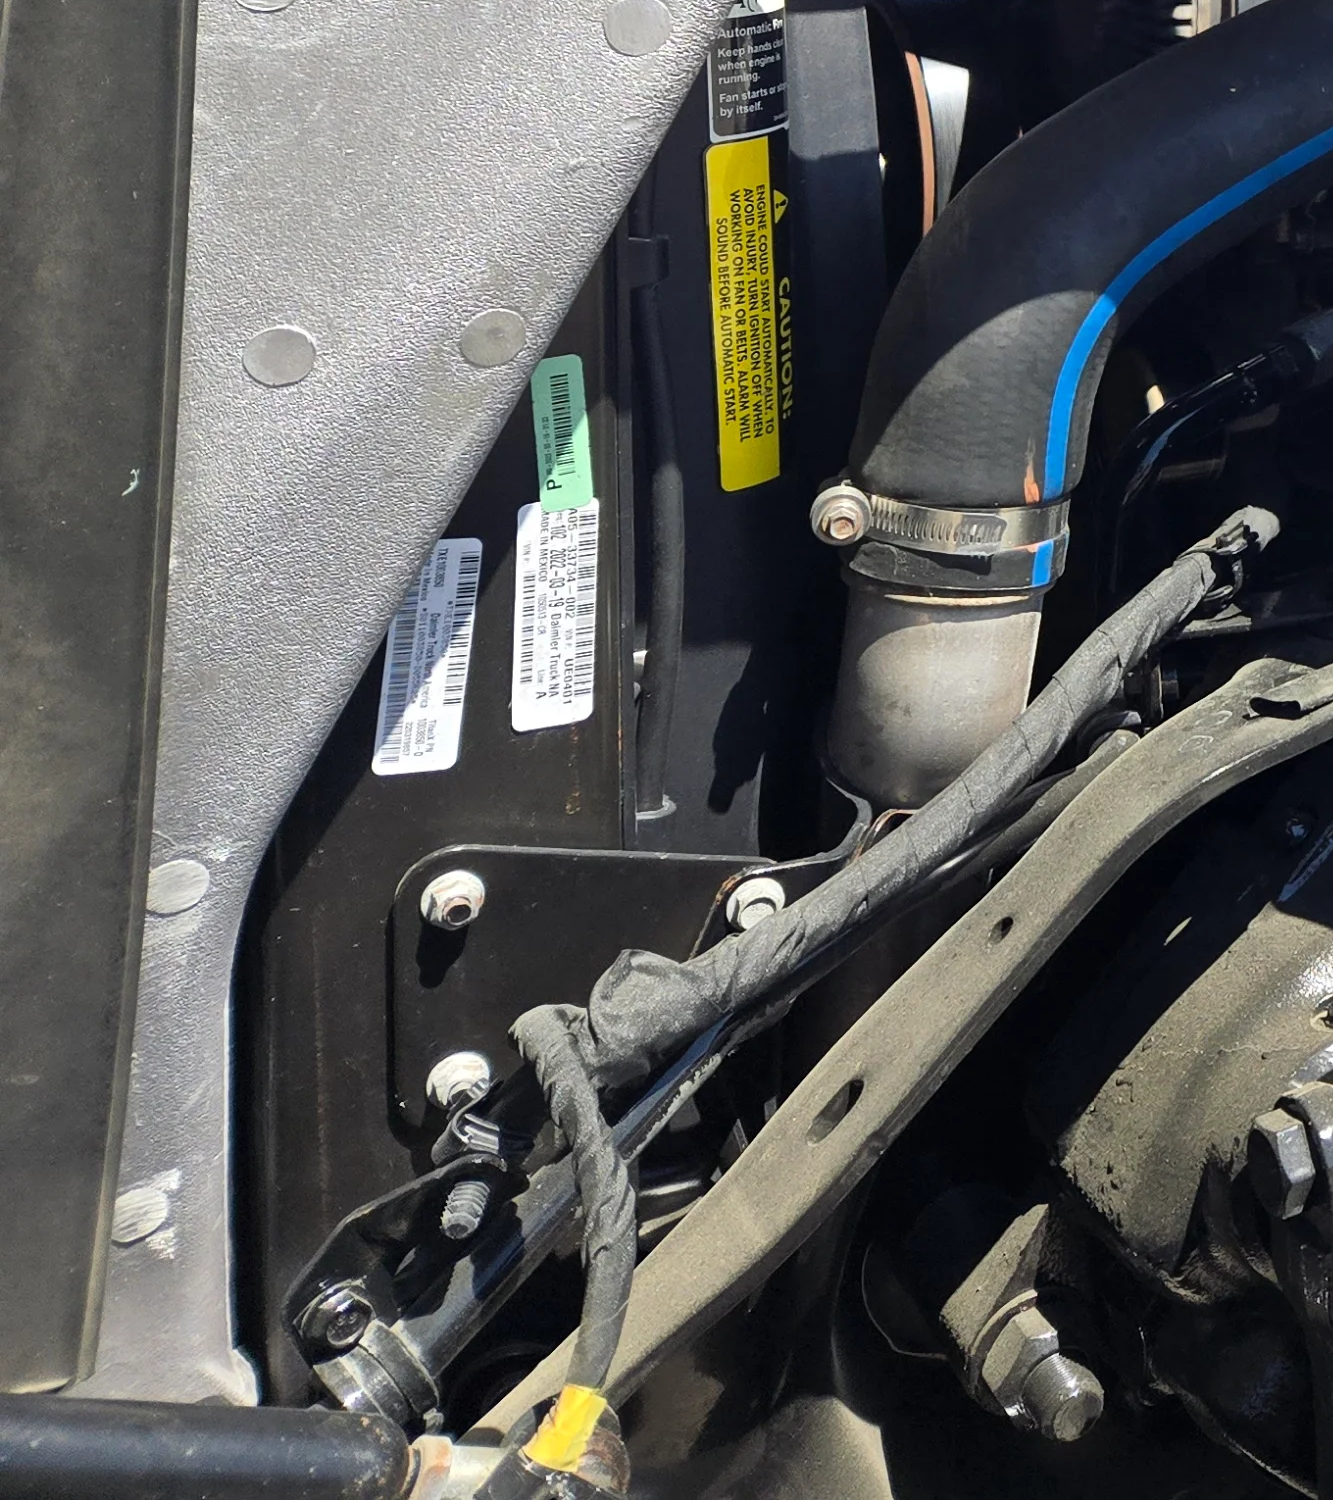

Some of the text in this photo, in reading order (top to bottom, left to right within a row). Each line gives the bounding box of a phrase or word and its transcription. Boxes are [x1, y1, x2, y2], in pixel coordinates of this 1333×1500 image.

[717, 21, 772, 39] Automatic
[717, 47, 745, 58] Keep
[747, 42, 772, 54] hands
[718, 61, 746, 71] when
[749, 55, 774, 67] engine
[719, 72, 760, 84] running.
[720, 93, 738, 103] Fan
[741, 88, 768, 100] starts
[720, 101, 763, 118] by itself.
[716, 217, 737, 426] SOUND BEFORE AUTOMATIC START.
[729, 189, 751, 443] WORKING ON FAN OR BELTS. ALARM WILL
[743, 188, 763, 439] AVOID INJURY, TURN IGNITION OFF WHEN
[756, 184, 775, 435] ENGINE COULD START AUTOMATICALLY. TO
[778, 277, 793, 419] CAUTION:
[540, 536, 549, 545] IN
[550, 525, 567, 540] 102
[538, 549, 548, 582] MEXICO
[548, 548, 566, 608] 2022-03-19
[421, 578, 431, 601] Mexico
[428, 612, 441, 639] Daimler
[550, 613, 562, 651] Daimler
[425, 640, 438, 659] Truck
[550, 653, 561, 681] Truck
[548, 683, 560, 698] NA
[563, 658, 574, 704] UE0401
[420, 680, 432, 708] America
[425, 743, 435, 753] PN
